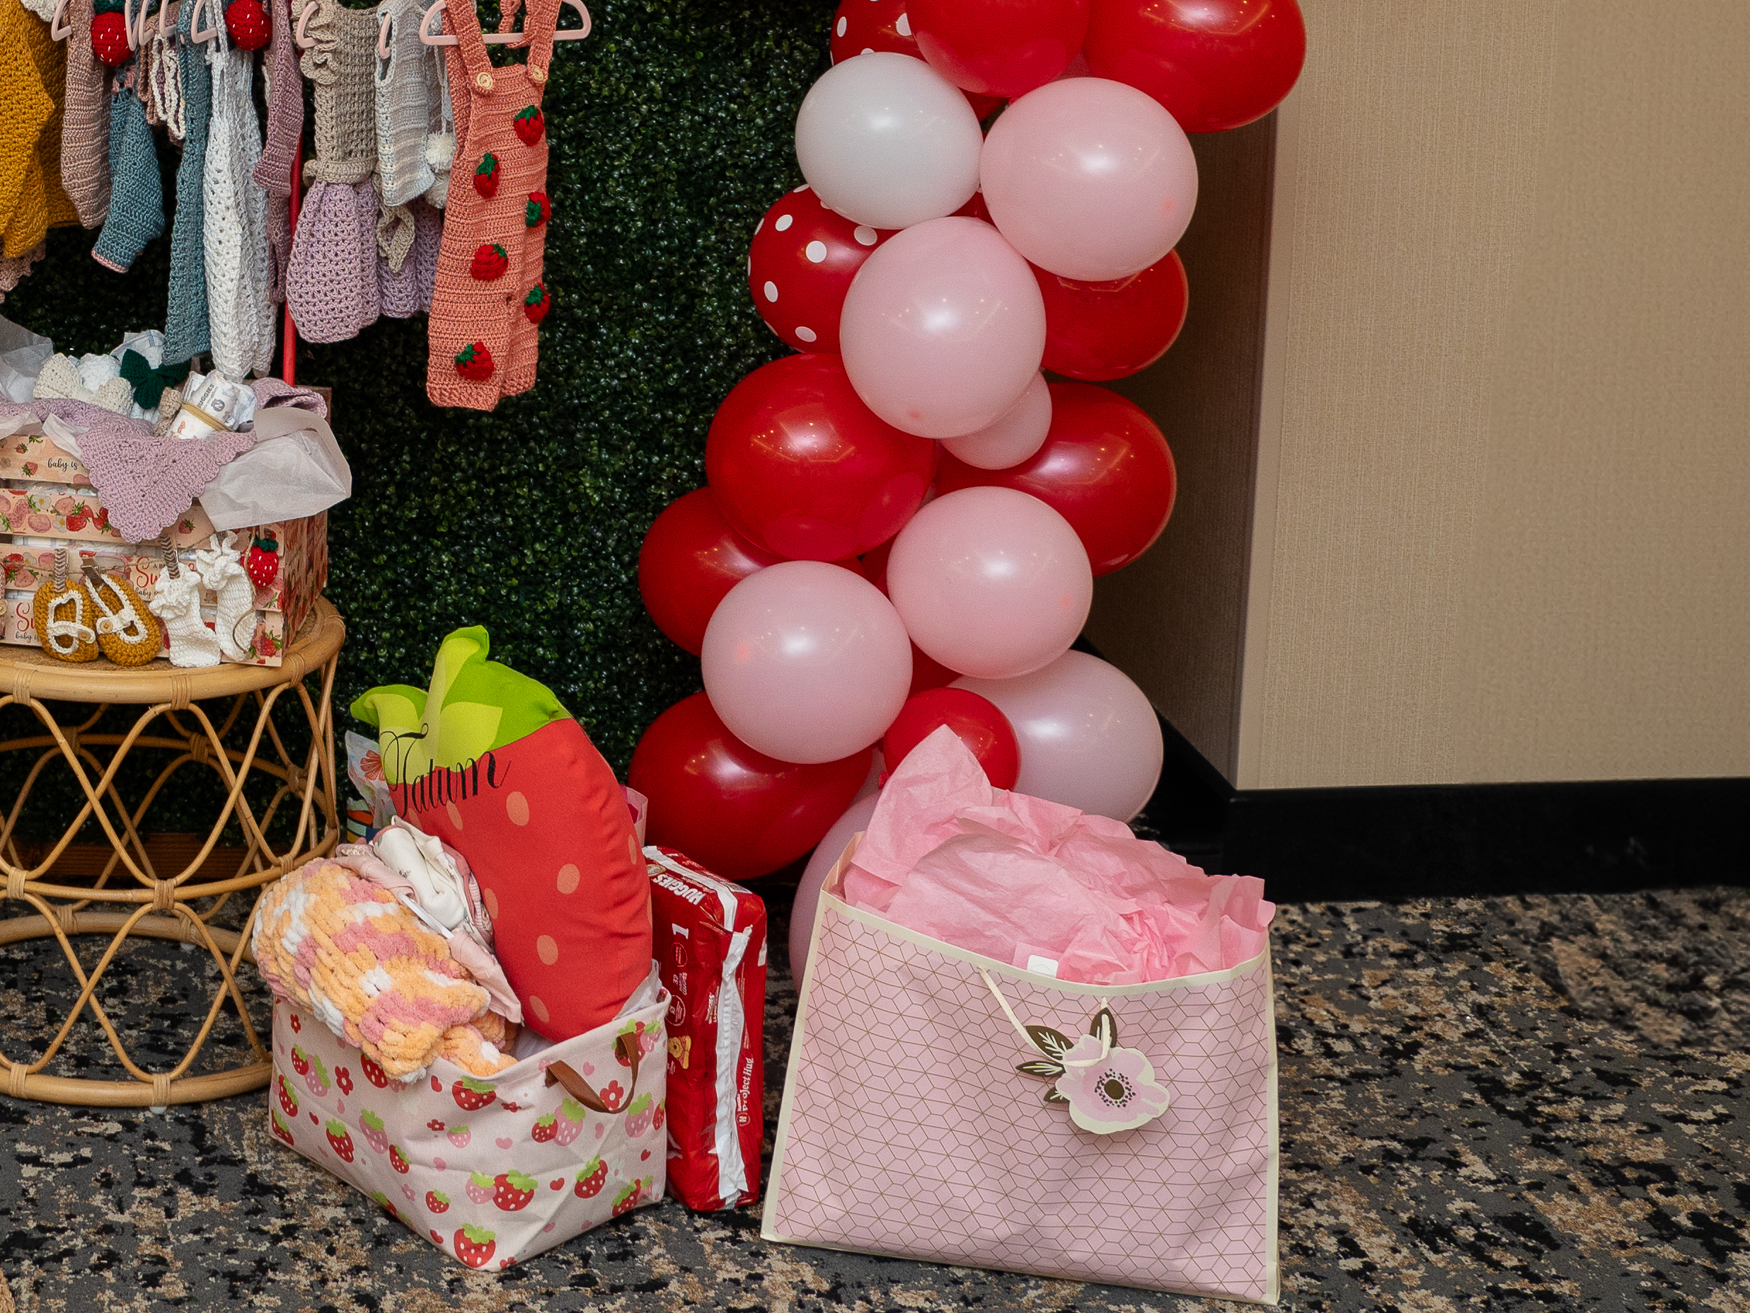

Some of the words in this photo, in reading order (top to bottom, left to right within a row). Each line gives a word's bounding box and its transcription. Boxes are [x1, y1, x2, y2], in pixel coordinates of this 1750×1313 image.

[47, 457, 68, 473] baby
[379, 722, 512, 819] Tatum
[652, 873, 707, 906] HUGGIES
[671, 922, 689, 939] 1
[742, 1056, 754, 1077] Hug
